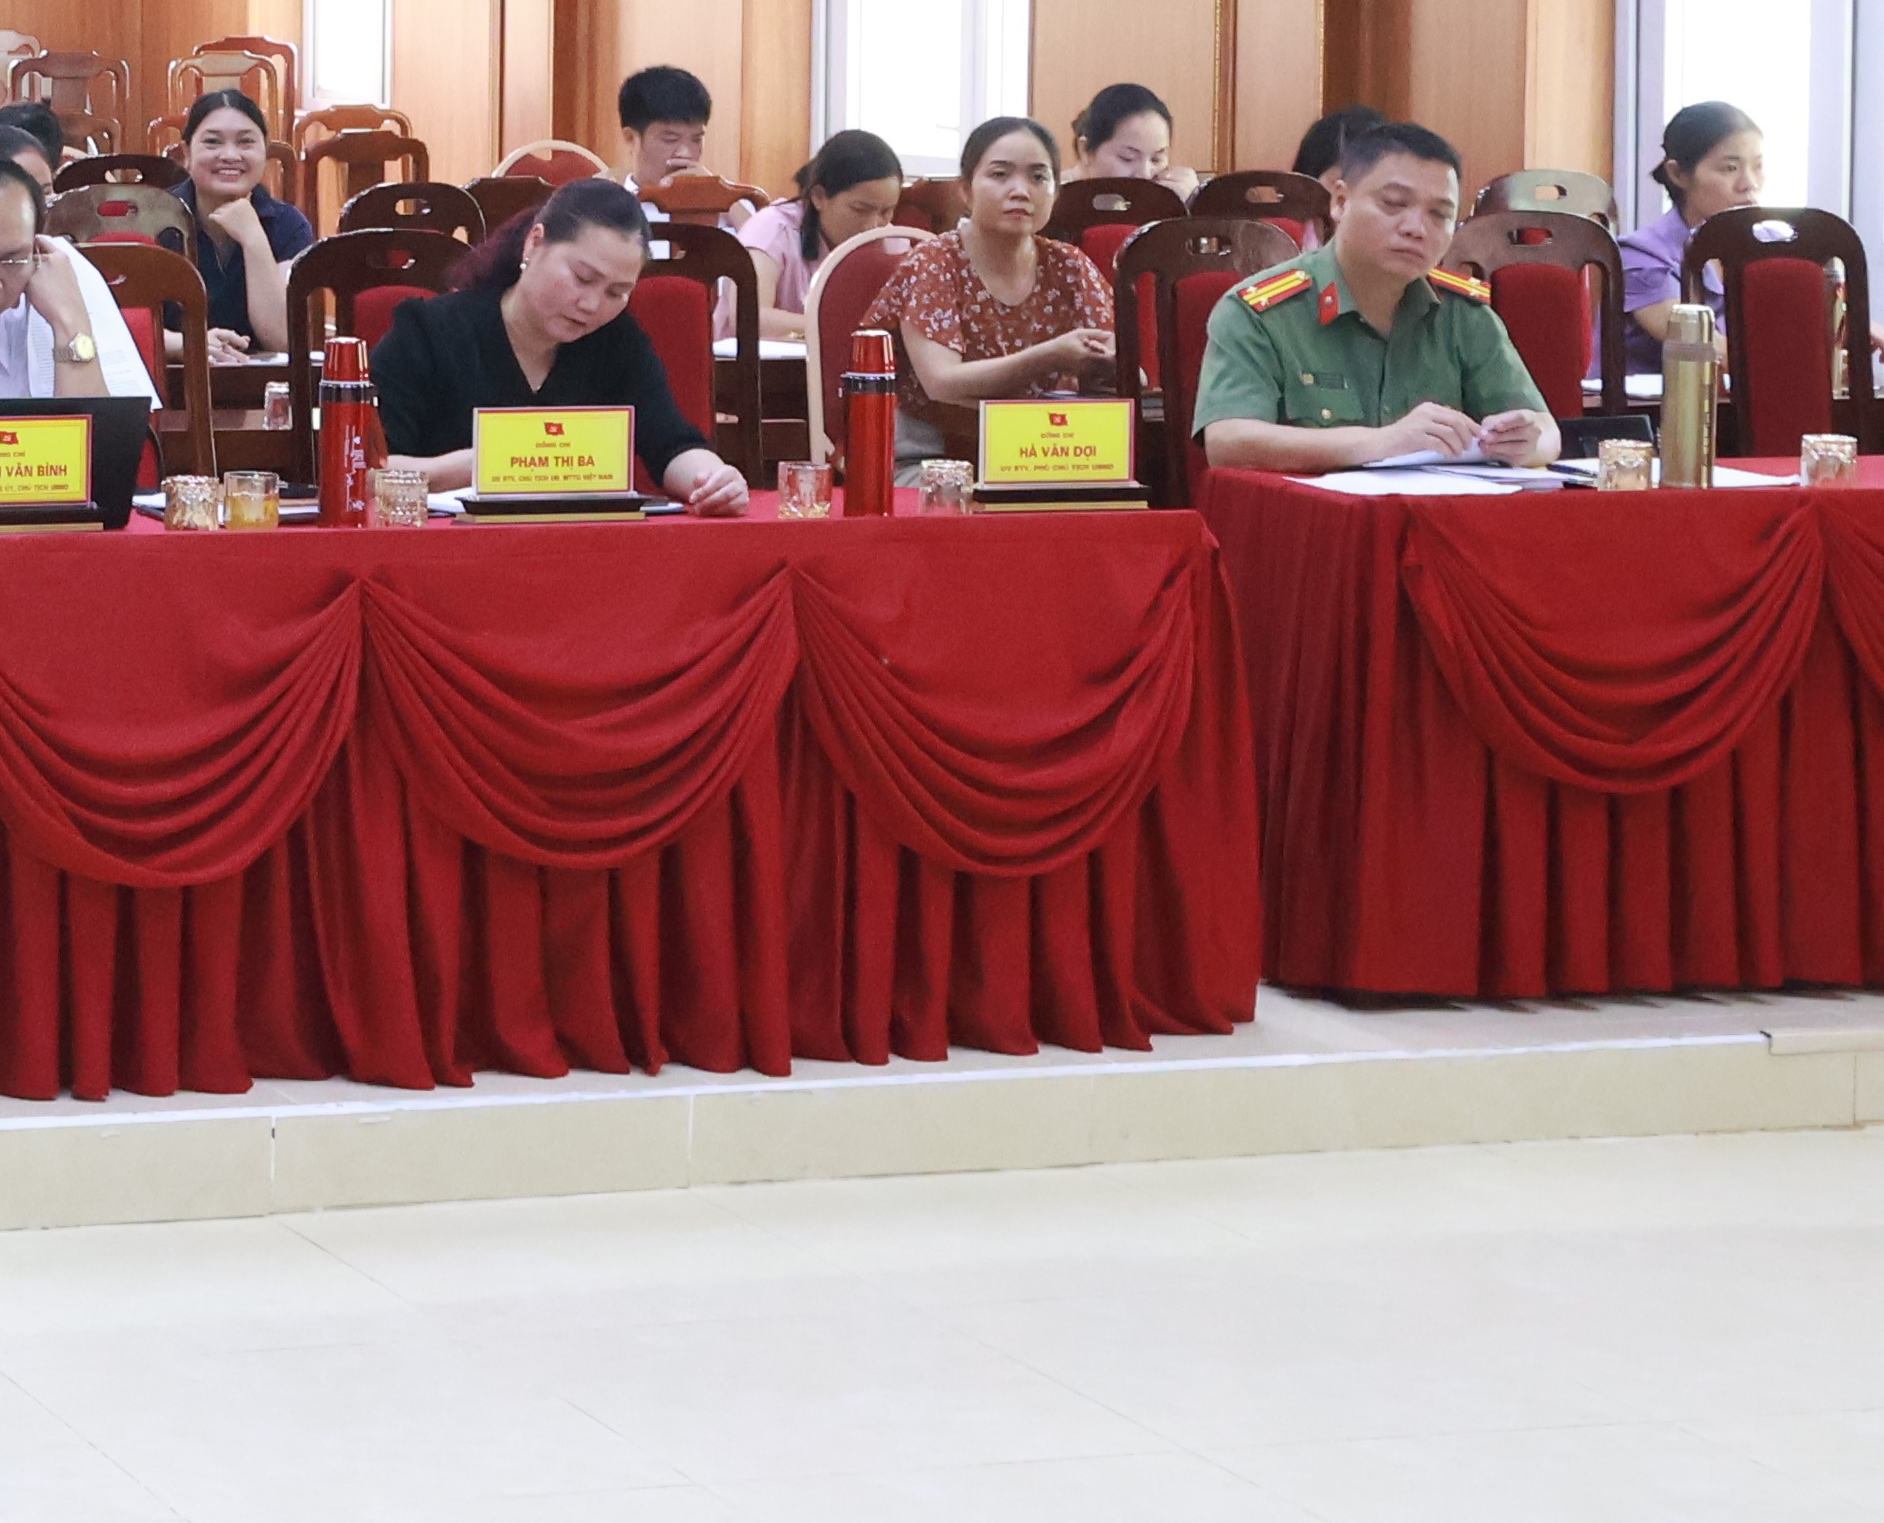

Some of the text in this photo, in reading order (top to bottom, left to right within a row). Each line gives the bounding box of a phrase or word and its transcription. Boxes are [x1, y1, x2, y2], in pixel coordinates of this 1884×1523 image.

[1020, 443, 1037, 458] HÀ
[6, 462, 33, 477] VĂN
[37, 462, 67, 476] BÌNH
[510, 456, 549, 472] PHẠM
[554, 455, 574, 470] THỊ
